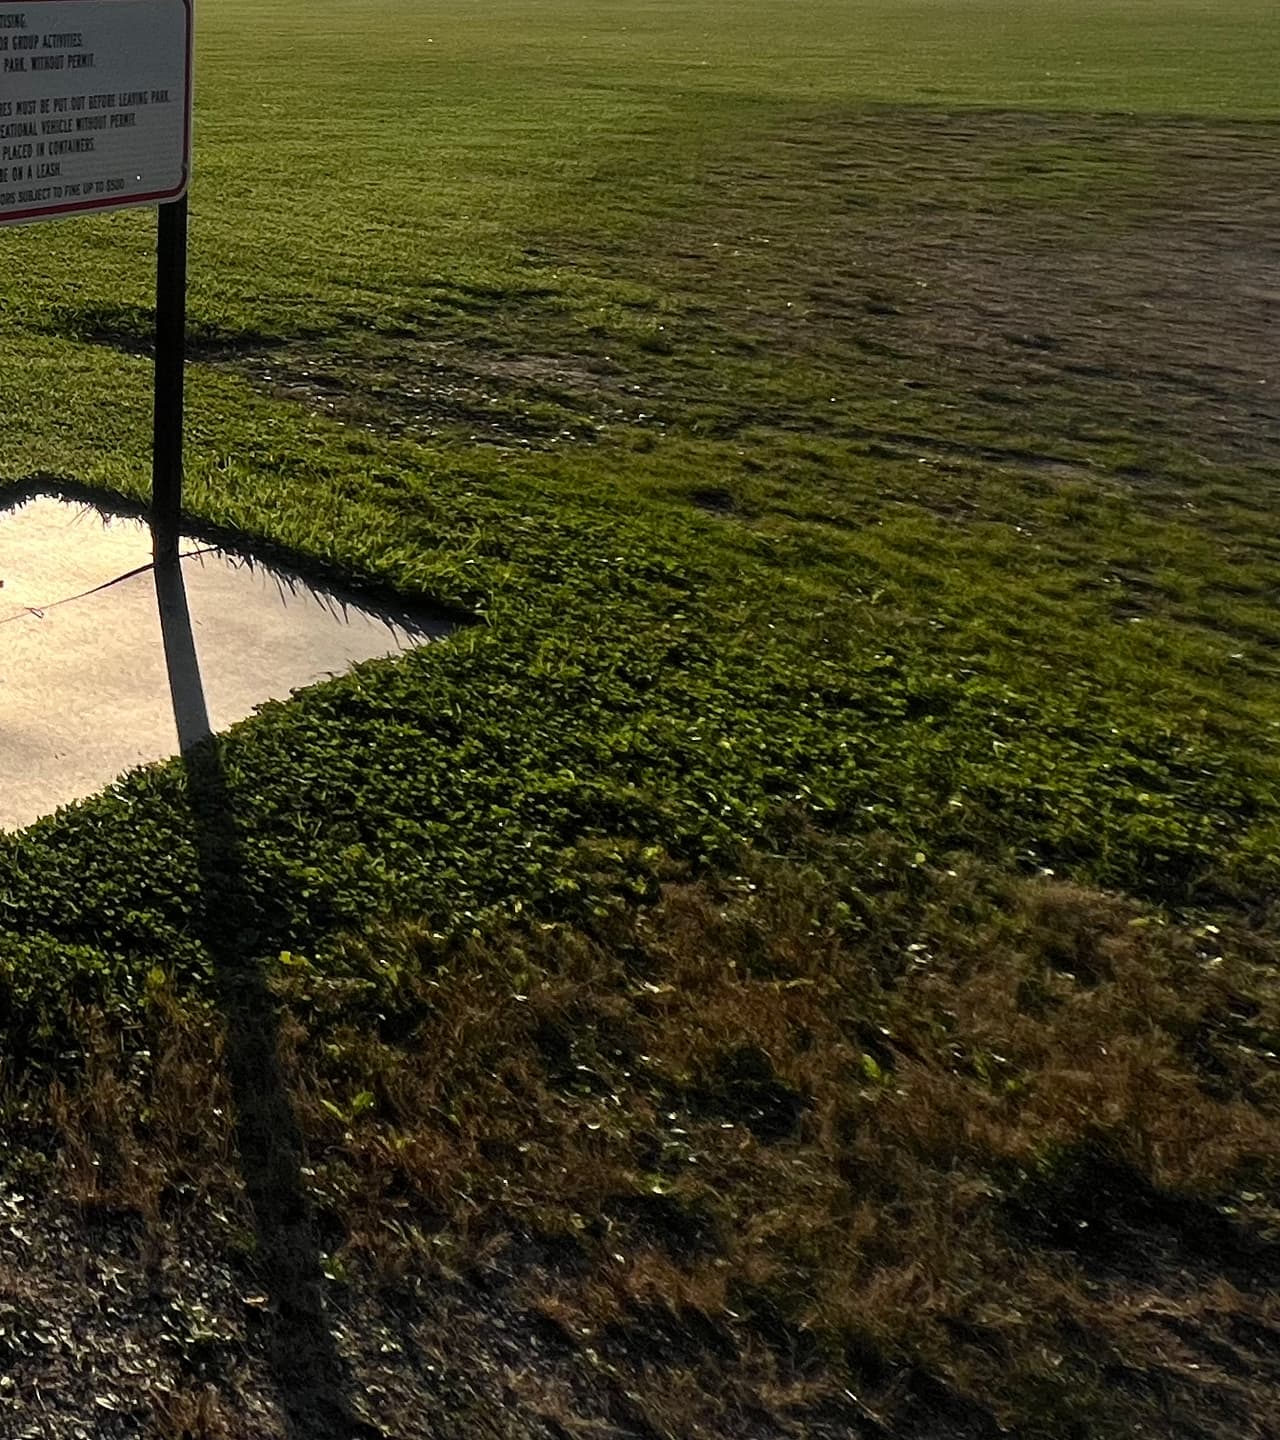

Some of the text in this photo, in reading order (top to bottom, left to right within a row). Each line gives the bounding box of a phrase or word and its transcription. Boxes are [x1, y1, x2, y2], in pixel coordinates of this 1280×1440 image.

[12, 35, 39, 50] GROUP
[31, 55, 65, 71] WITHOUT
[16, 100, 36, 115] MUST
[40, 99, 50, 114] BE
[54, 98, 67, 112] PUT
[71, 96, 85, 111] OUT
[89, 94, 115, 109] BEFORE
[119, 91, 148, 107] LEAVING
[42, 117, 73, 135] VEHICLE
[76, 115, 107, 131] WITHOUT
[2, 143, 32, 160] PLACED
[36, 142, 45, 157] IN
[12, 166, 23, 181] ON
[27, 164, 33, 179] A
[18, 188, 51, 202] SUBJECT
[53, 186, 63, 198] TO
[65, 183, 81, 196] FINE
[83, 182, 93, 194] UP
[95, 180, 105, 192] TO
